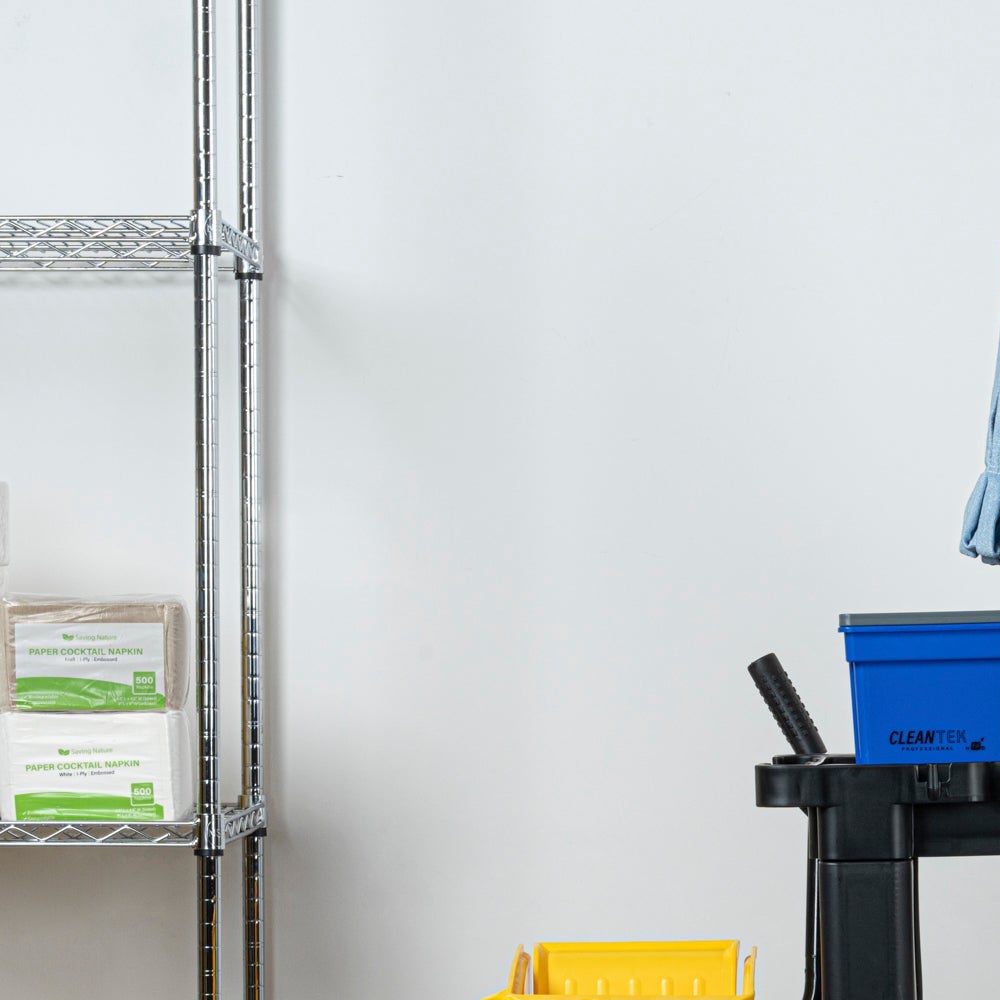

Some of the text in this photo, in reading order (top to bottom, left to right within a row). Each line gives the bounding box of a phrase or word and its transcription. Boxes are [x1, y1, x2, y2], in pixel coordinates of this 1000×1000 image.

[29, 648, 143, 656] PAPER COCKTAIL NAPKIN
[135, 676, 154, 685] 500
[889, 729, 967, 745] CLEANTEK
[25, 760, 140, 772] PAPER COCKTAIL NAPKIN
[133, 787, 152, 796] 500
